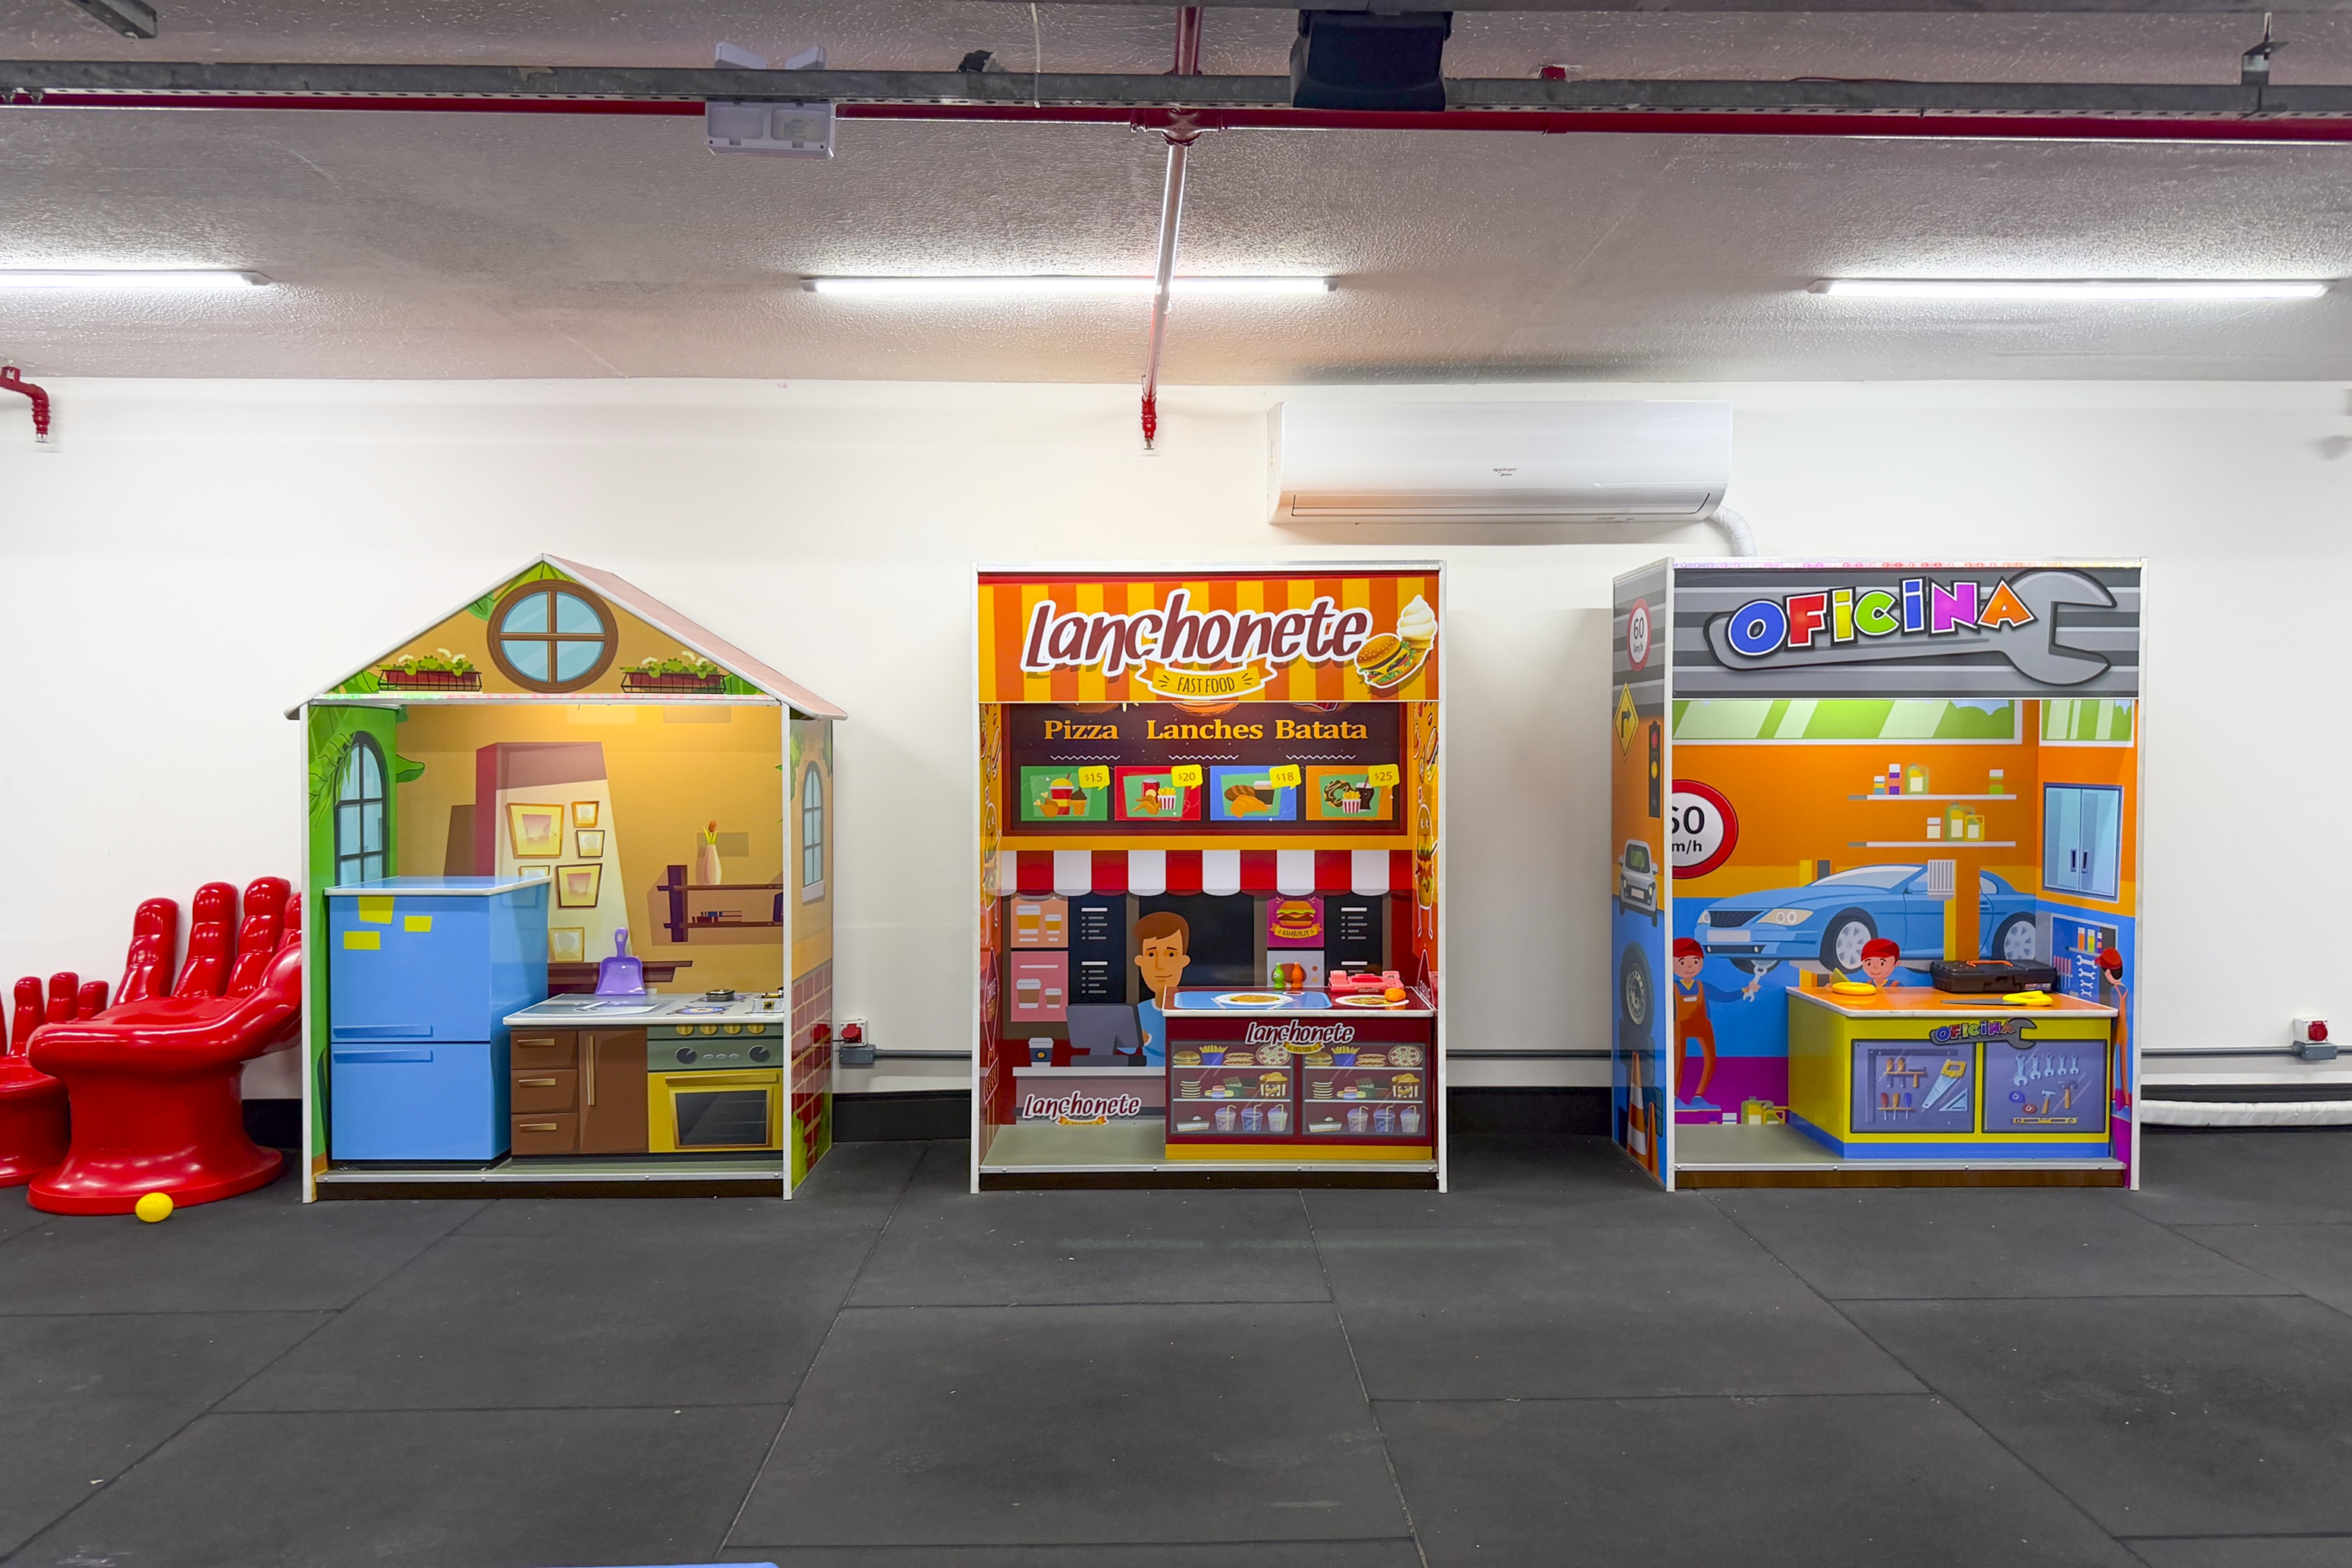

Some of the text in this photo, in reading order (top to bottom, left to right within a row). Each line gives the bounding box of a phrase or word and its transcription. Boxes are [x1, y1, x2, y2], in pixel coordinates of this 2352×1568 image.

[1023, 592, 1369, 673] Lanchonete
[1634, 617, 1645, 639] 60
[1178, 677, 1235, 693] FAST FOOD
[1043, 718, 1369, 740] Pizza Lanches Batata
[1085, 772, 1102, 782] $15
[1178, 771, 1196, 781] $20
[1276, 771, 1294, 782] $18
[1374, 771, 1392, 781] $25
[1247, 1020, 1354, 1045] Lanchonete
[1023, 1092, 1140, 1118] Lanchonete
